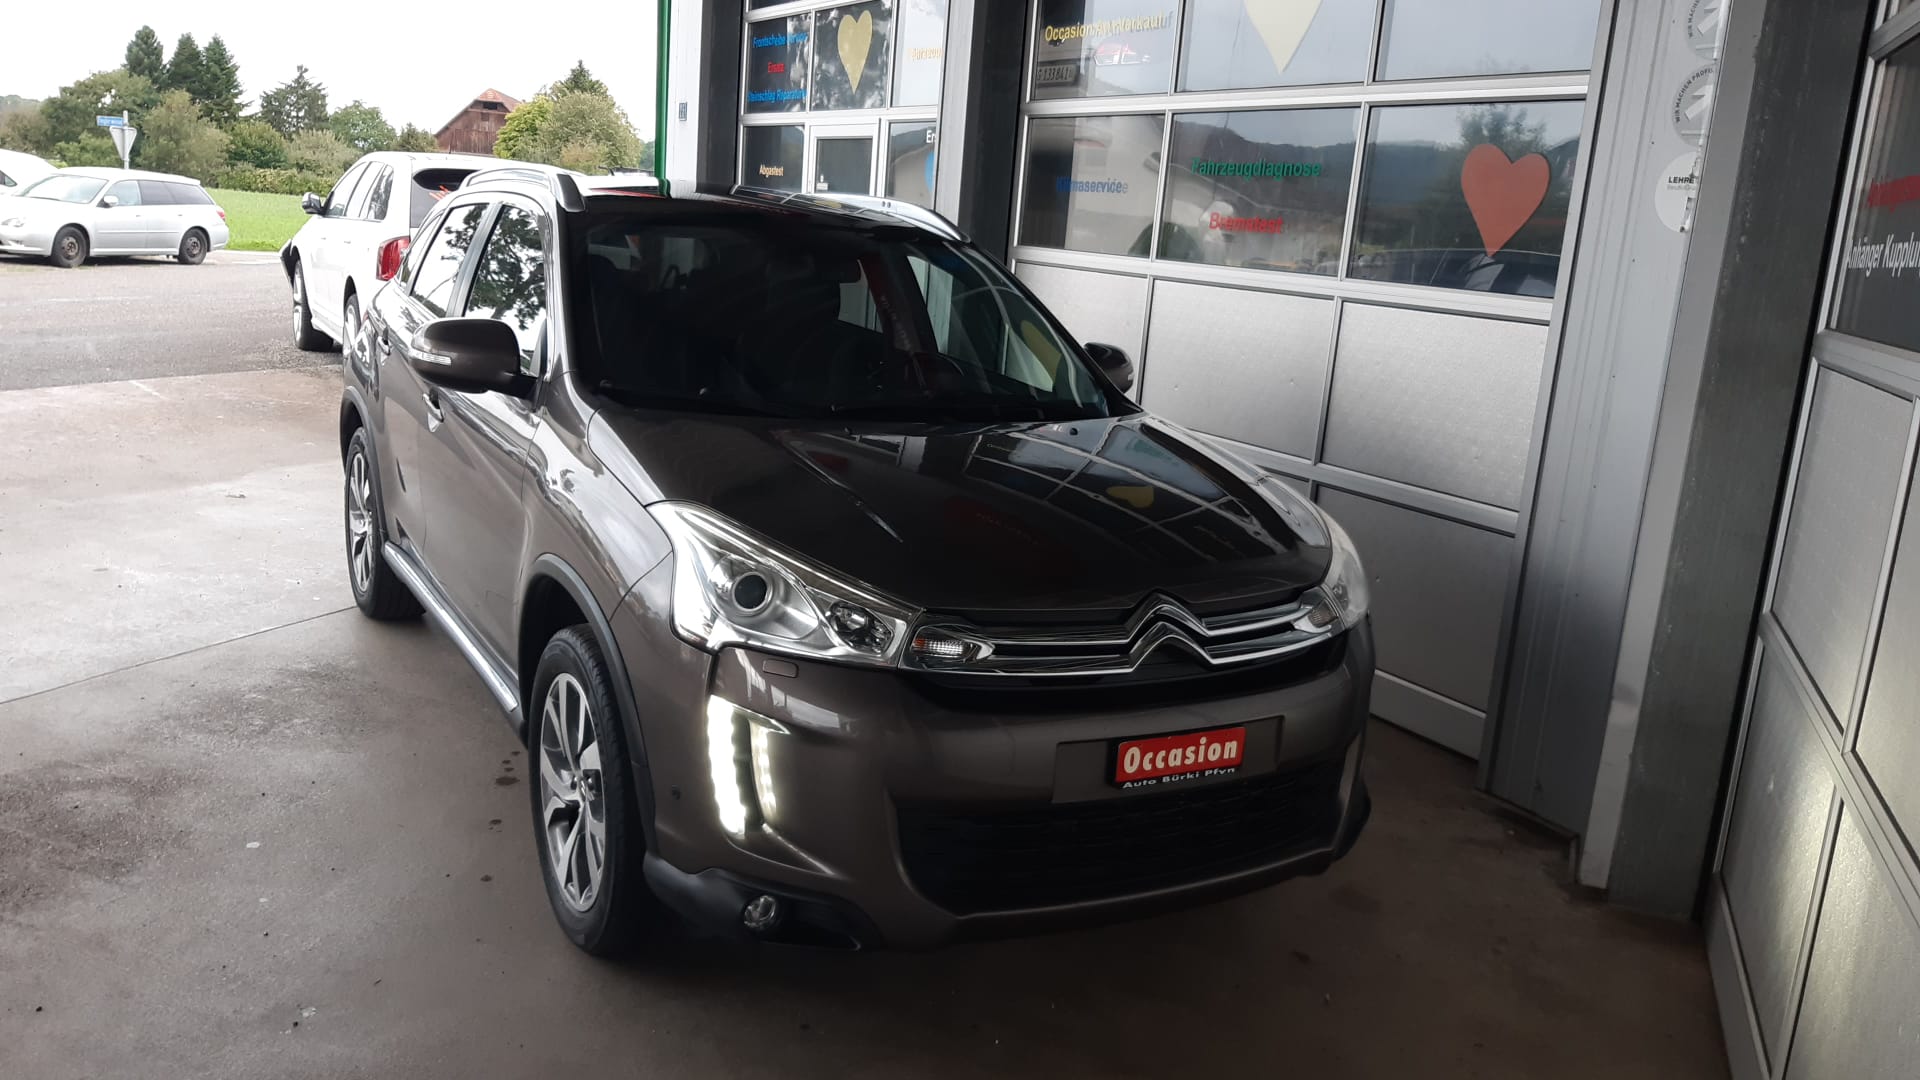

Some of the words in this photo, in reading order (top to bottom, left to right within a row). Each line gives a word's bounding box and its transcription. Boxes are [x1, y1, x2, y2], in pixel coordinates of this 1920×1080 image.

[1190, 157, 1322, 181] Fahrzeugdiagnose
[1208, 212, 1284, 234] Bremstest
[1882, 232, 1920, 277] Kupplun
[1123, 736, 1238, 774] Occasion
[1122, 779, 1157, 789] Auto
[1162, 771, 1200, 783] Bürki
[1204, 767, 1236, 776] Pfyn
